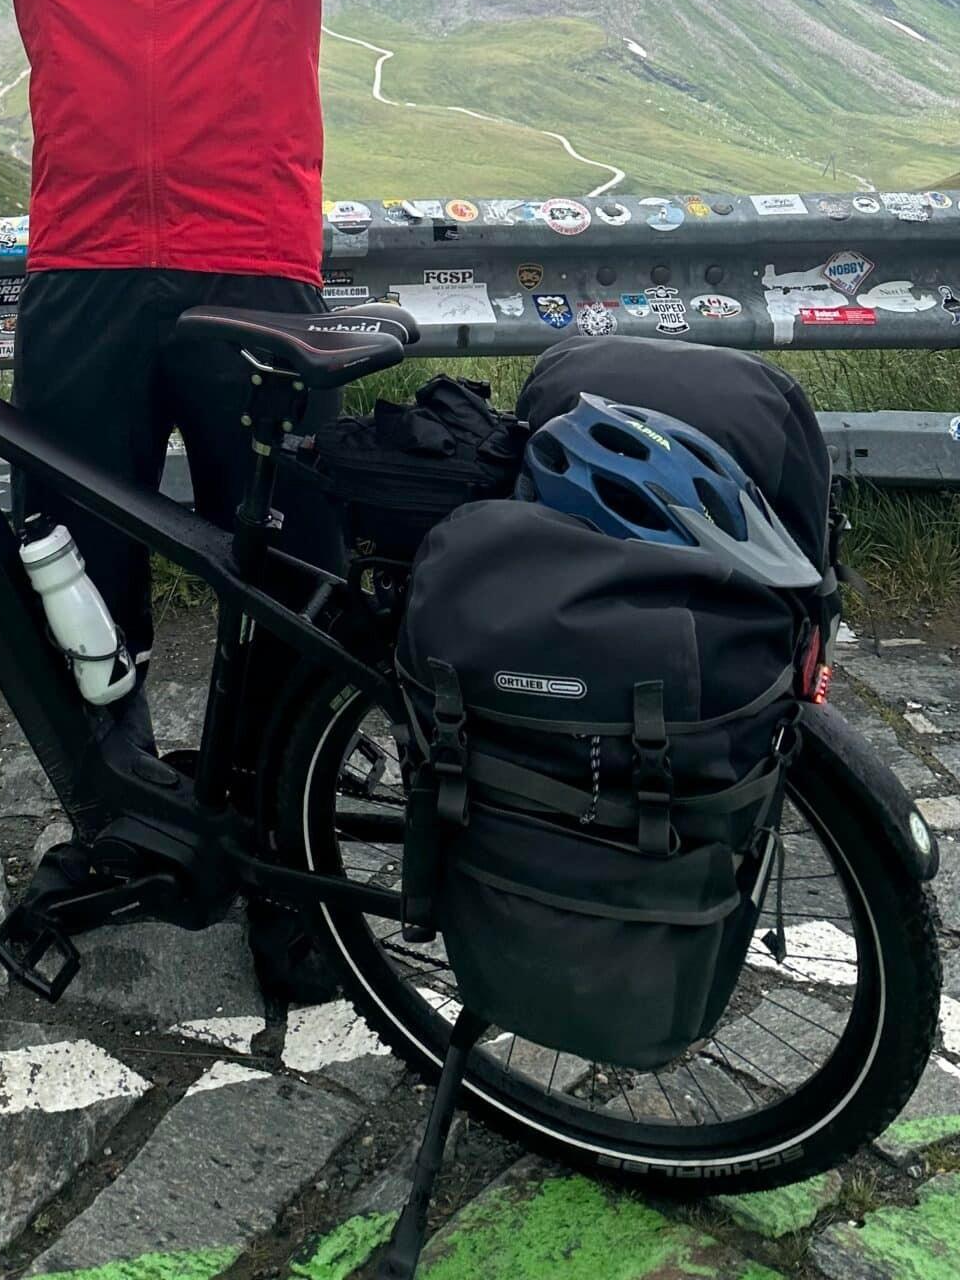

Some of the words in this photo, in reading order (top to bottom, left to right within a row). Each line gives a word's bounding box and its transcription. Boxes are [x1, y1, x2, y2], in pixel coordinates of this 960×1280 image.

[829, 261, 866, 277] NOBBY
[323, 286, 368, 297] IVE4x4.COM
[3, 295, 20, 303] TEA
[651, 303, 685, 313] MOPED
[661, 313, 683, 324] RIDE
[499, 676, 544, 691] ORTLIEB
